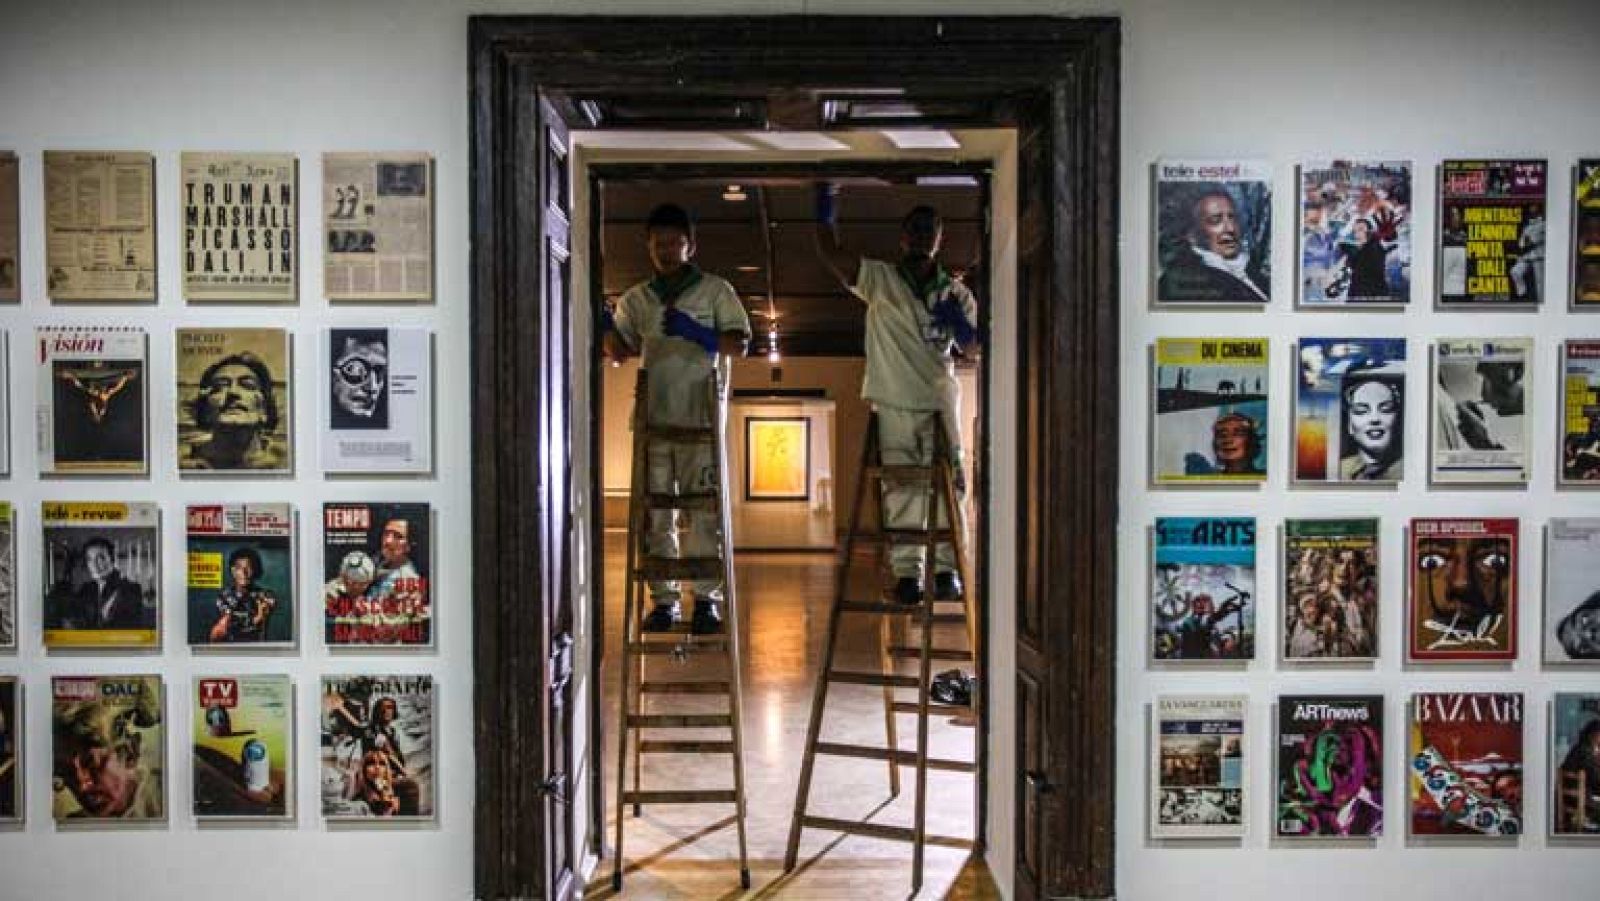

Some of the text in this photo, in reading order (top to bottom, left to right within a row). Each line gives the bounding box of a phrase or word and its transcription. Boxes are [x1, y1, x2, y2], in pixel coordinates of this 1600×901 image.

[186, 183, 291, 205] TRUMAN
[186, 206, 291, 228] MARSHALL
[186, 229, 291, 249] PICASSO
[1468, 224, 1518, 240] LENNON
[268, 251, 291, 273] IN
[1202, 341, 1217, 358] DU
[327, 508, 370, 529] TEMPO
[1192, 520, 1255, 546] ARTS
[203, 683, 233, 697] TV
[1293, 704, 1369, 720] ARTnews
[1416, 694, 1521, 722] BAZAAR
